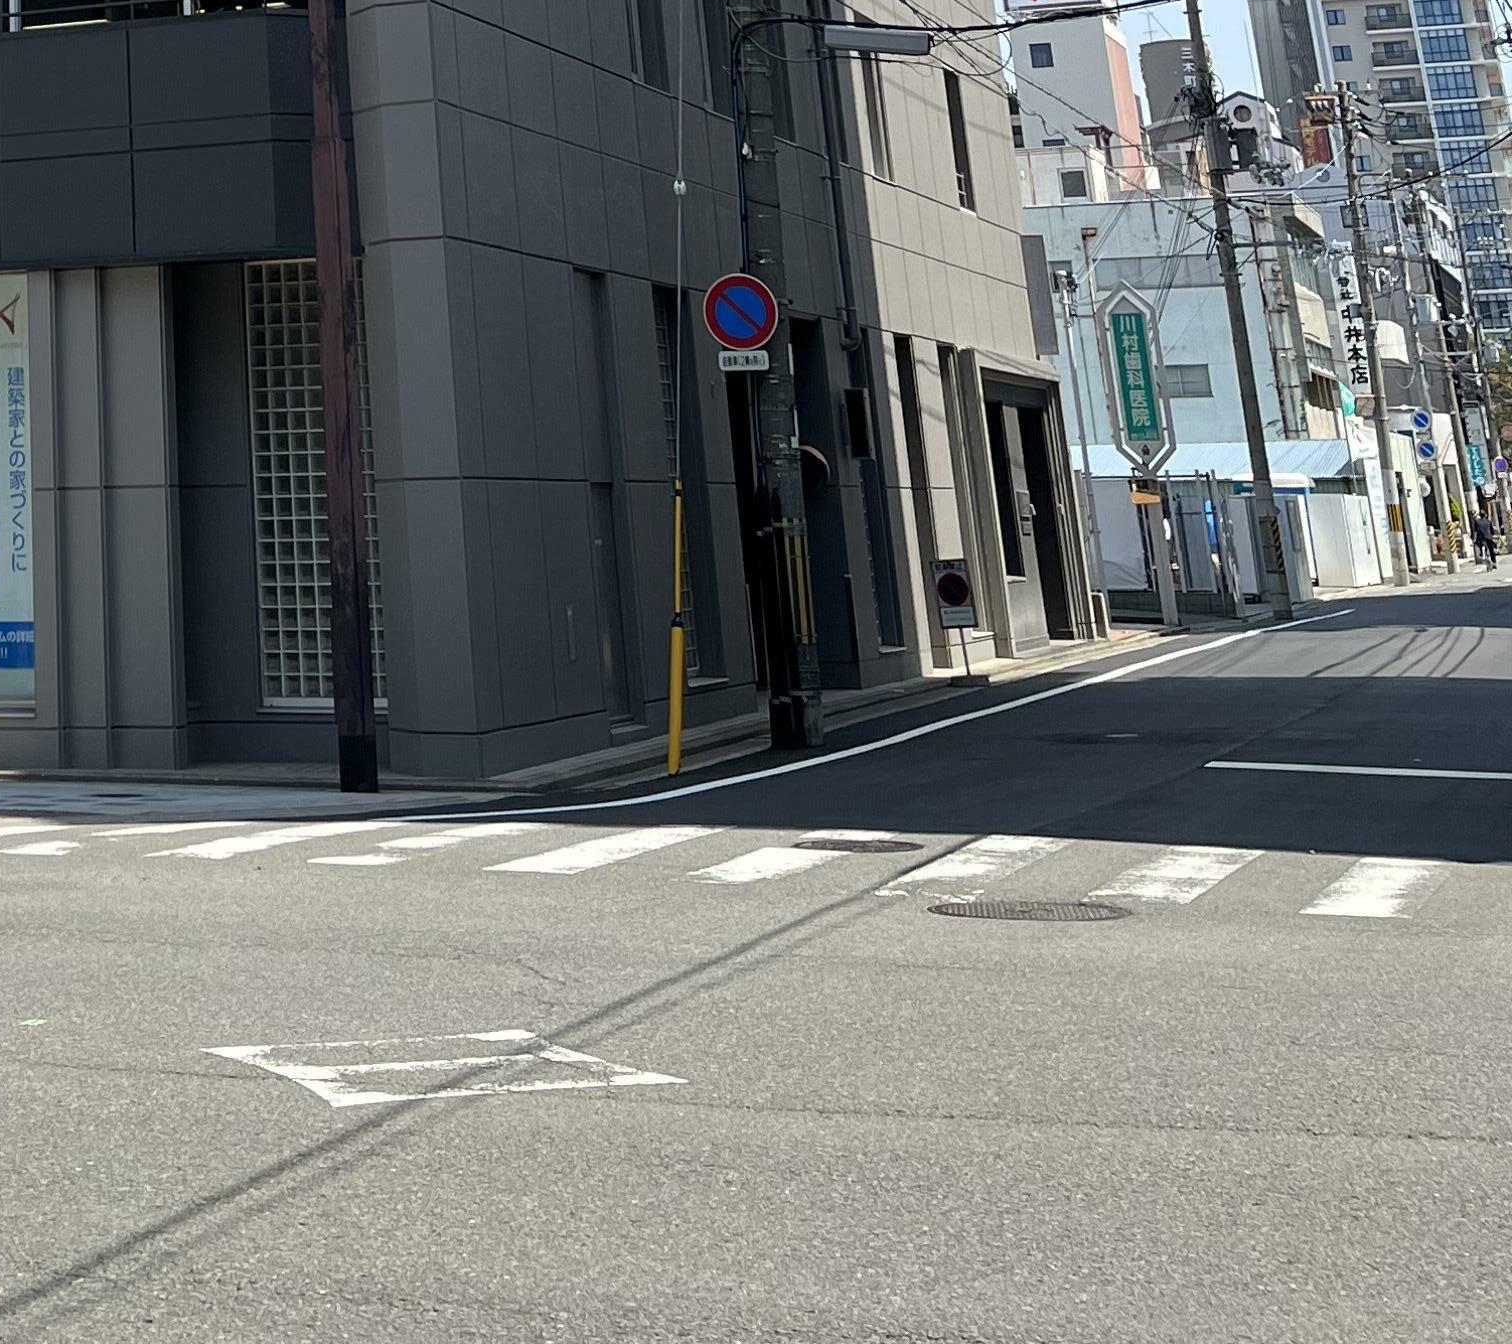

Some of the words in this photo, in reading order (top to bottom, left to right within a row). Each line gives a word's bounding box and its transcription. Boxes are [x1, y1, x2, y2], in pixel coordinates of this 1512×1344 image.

[1119, 315, 1151, 427] 川村歯科医院
[7, 367, 27, 572] 建築家との家づくりに
